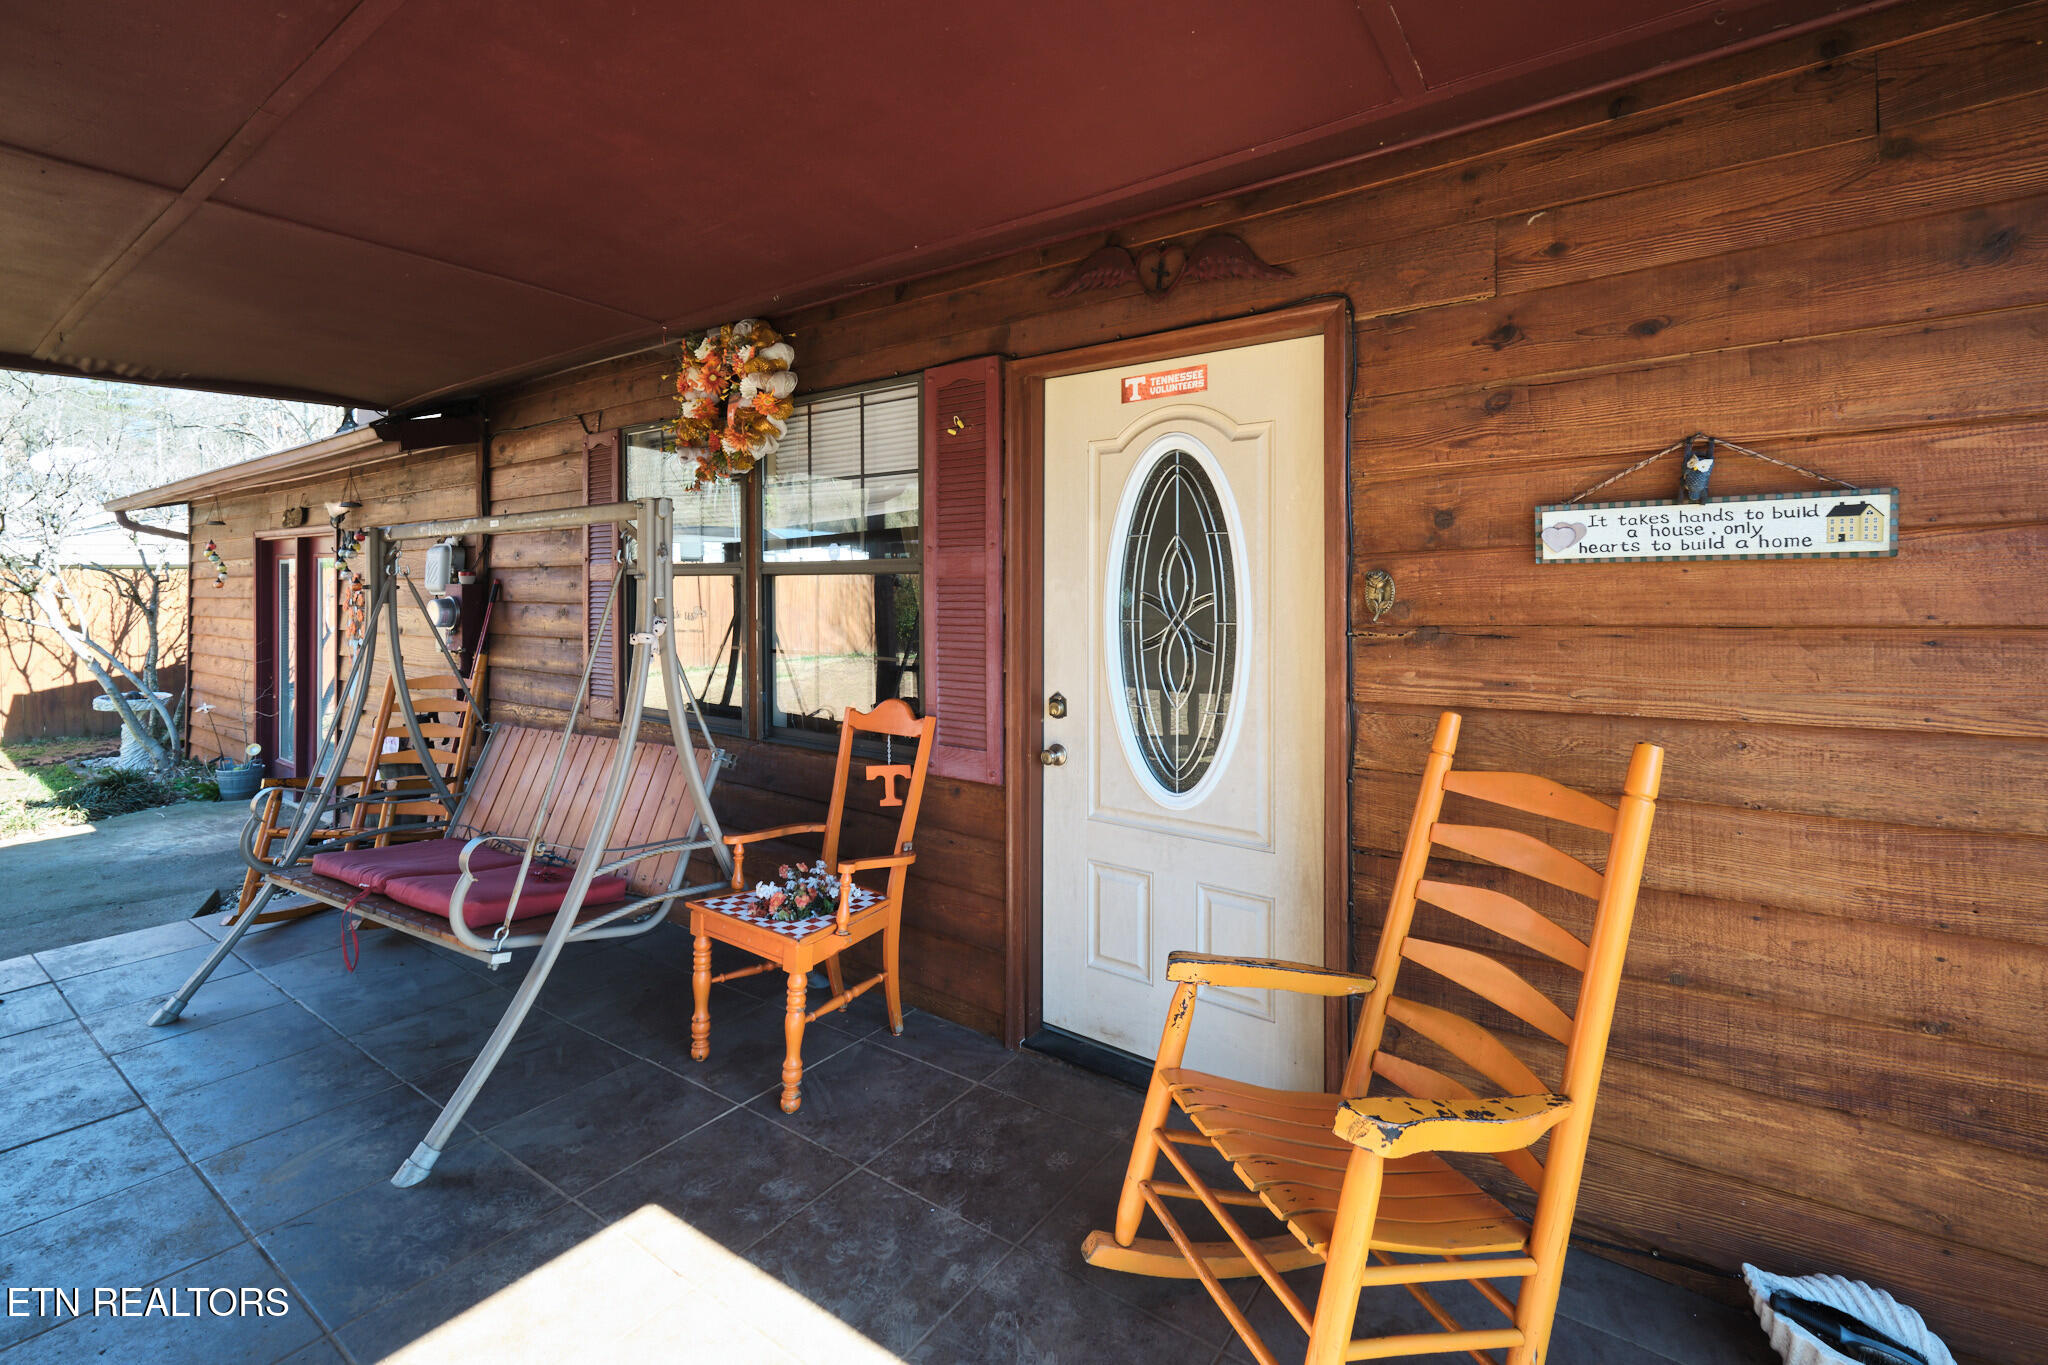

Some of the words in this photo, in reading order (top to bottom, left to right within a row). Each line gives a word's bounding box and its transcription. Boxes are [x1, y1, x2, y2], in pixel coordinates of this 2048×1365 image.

[1150, 369, 1204, 386] TENNESSEE
[1150, 379, 1204, 395] VOLUNTEERS
[1587, 515, 1608, 528] It
[1618, 513, 1670, 526] takes
[1679, 508, 1734, 523] hands
[1745, 509, 1764, 520] to
[1772, 504, 1820, 519] build
[1627, 528, 1638, 538] a
[1724, 521, 1763, 539] only
[1579, 541, 1640, 553] hearts
[1651, 540, 1671, 552] to
[1681, 536, 1725, 551] build
[1736, 539, 1749, 549] a
[1759, 535, 1813, 548] home
